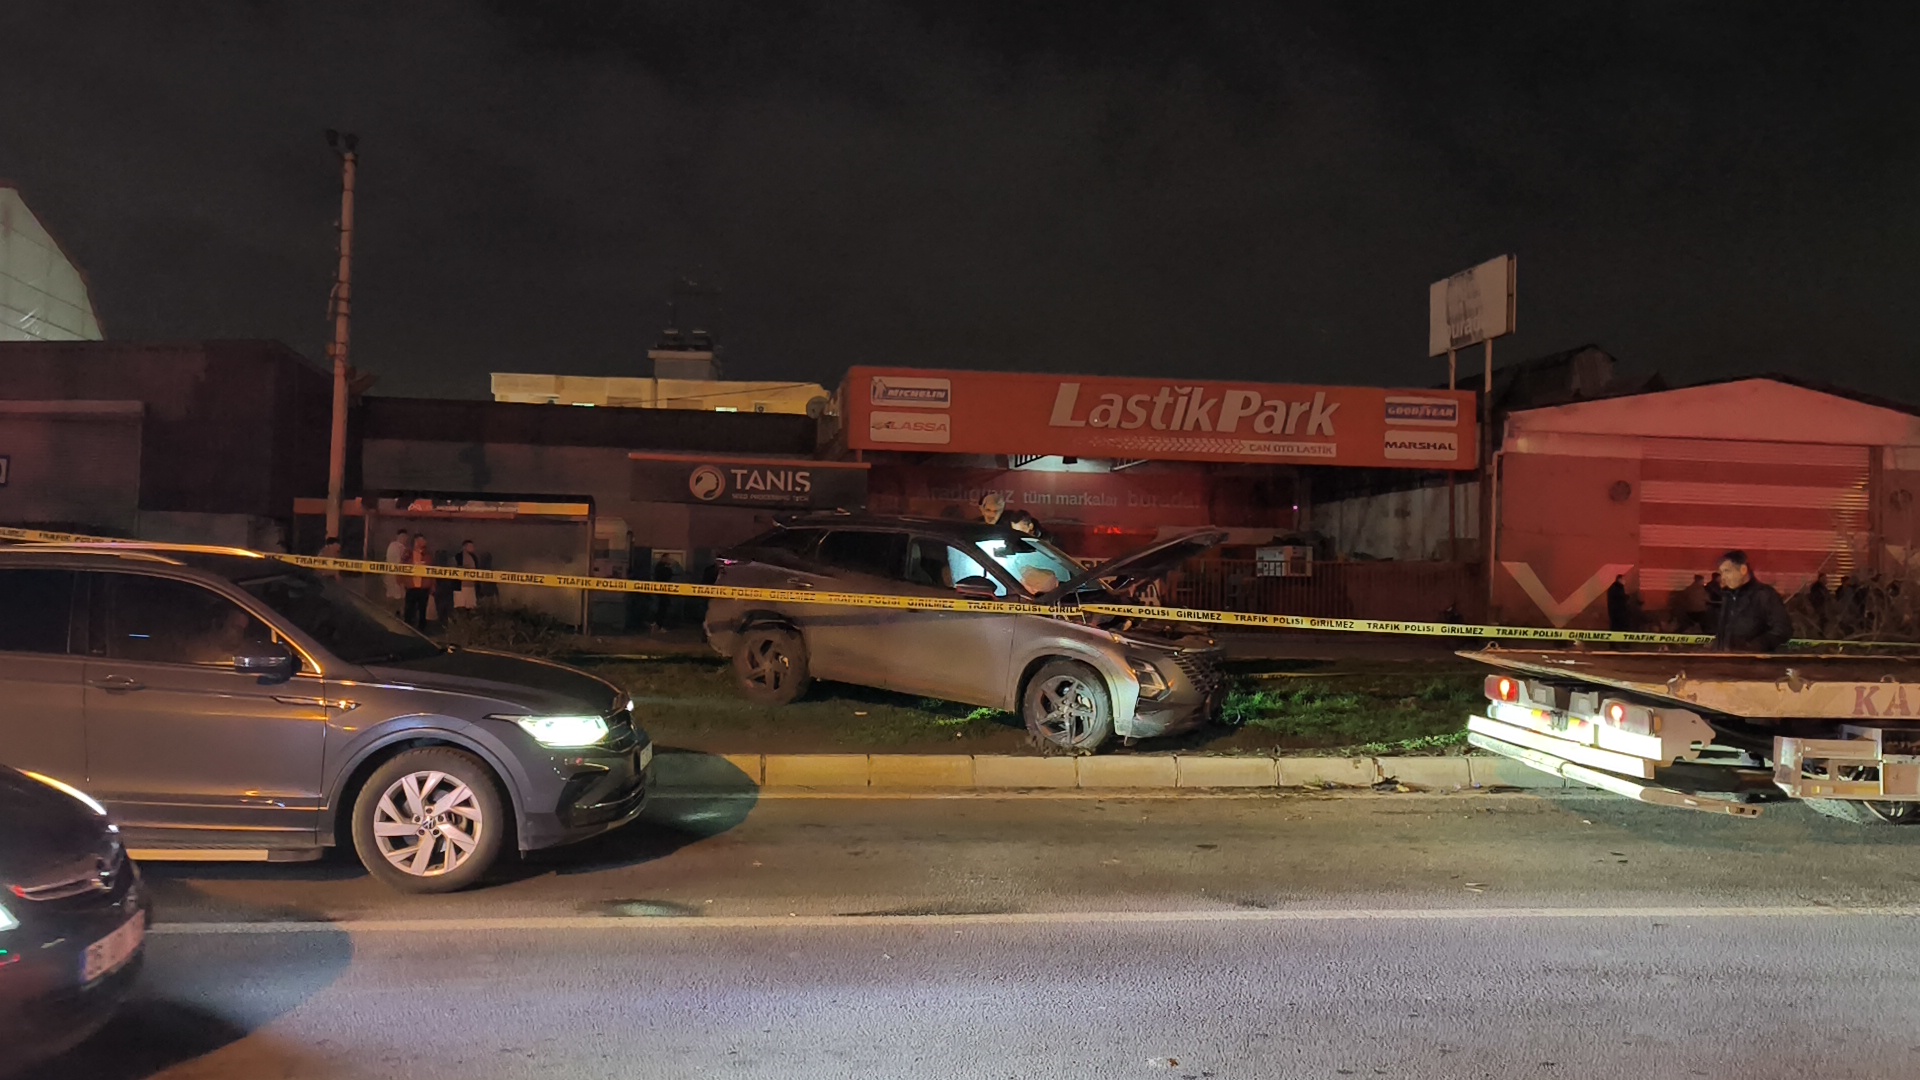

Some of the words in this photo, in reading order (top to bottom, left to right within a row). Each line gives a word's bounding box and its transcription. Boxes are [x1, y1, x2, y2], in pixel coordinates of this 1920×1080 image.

[887, 389, 947, 399] MICHELIN
[1387, 406, 1455, 417] GOODYEAR
[889, 421, 947, 432] LASSA
[1249, 444, 1271, 453] CAN
[1274, 445, 1294, 453] OTO
[1385, 441, 1456, 451] MARSHAL
[730, 469, 811, 493] TANIS
[1023, 490, 1051, 505] tüm
[1055, 491, 1118, 507] markalar
[1852, 685, 1920, 716] KA
